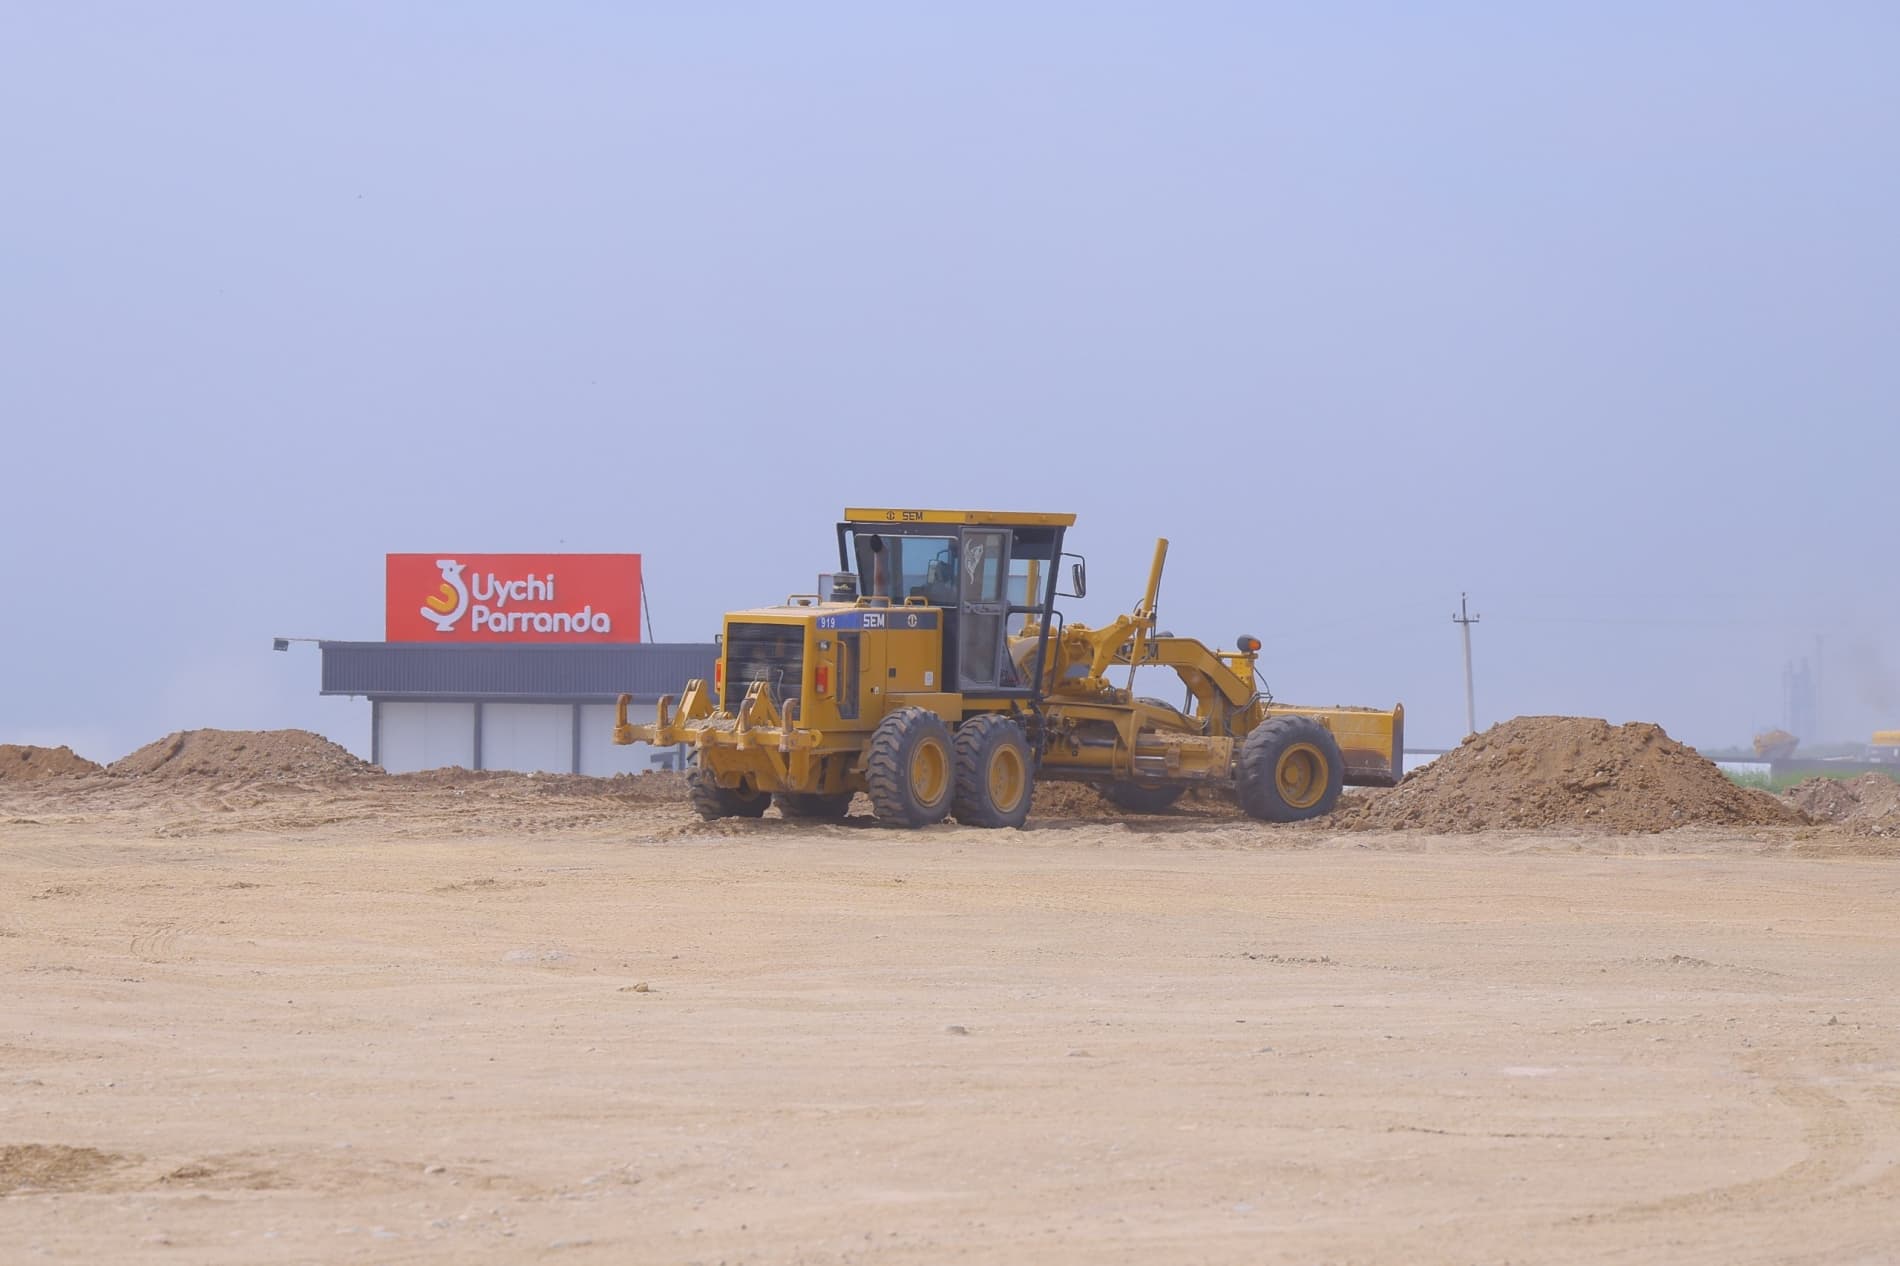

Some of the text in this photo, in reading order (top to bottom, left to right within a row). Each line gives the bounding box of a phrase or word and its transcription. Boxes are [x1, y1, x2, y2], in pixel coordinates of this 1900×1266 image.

[902, 511, 923, 521] SEM
[471, 573, 554, 607] Uychi
[471, 605, 610, 633] Parranda
[820, 617, 835, 628] 919
[863, 613, 885, 628] SEM
